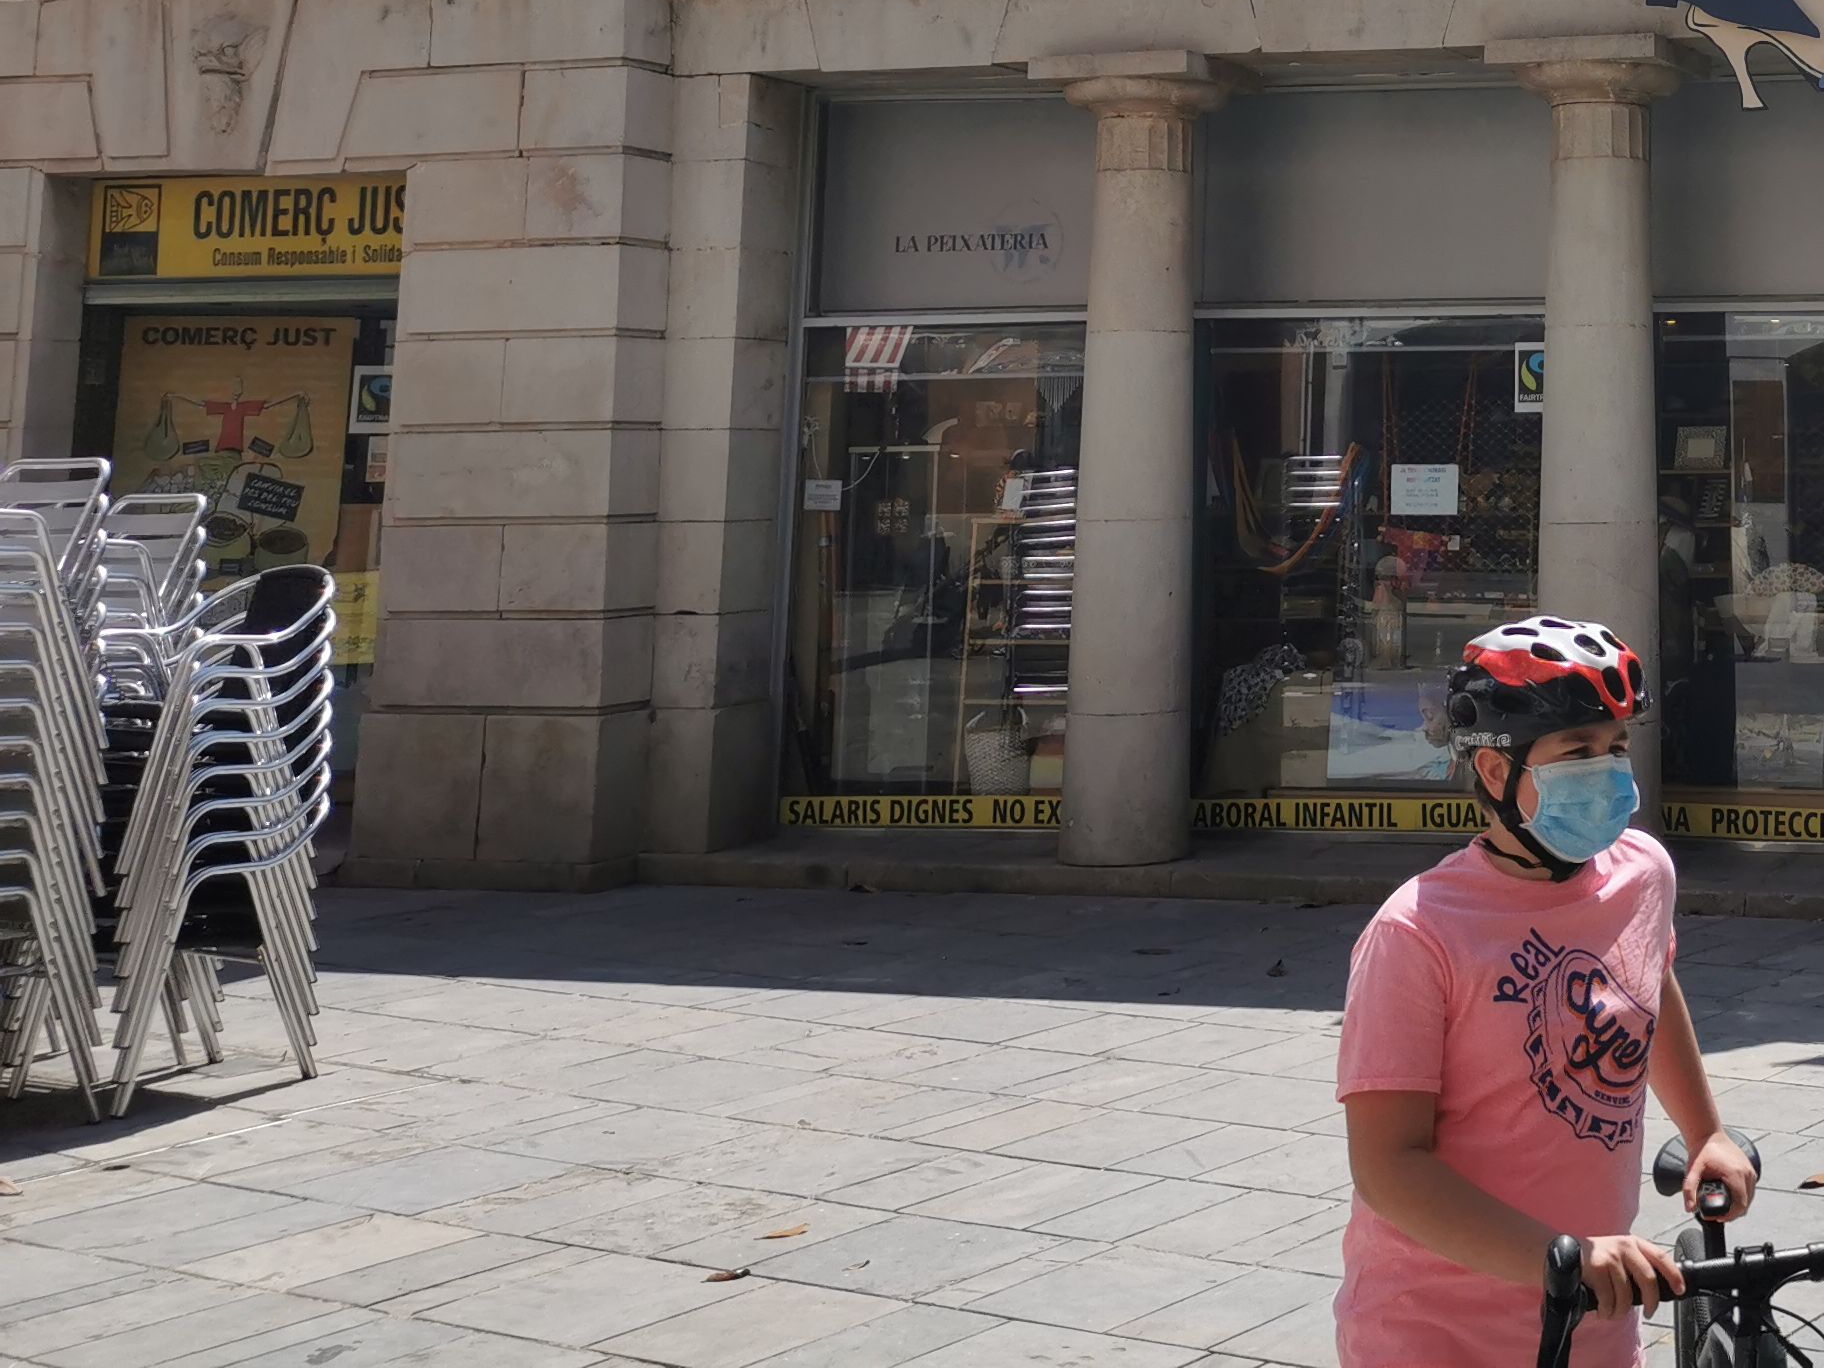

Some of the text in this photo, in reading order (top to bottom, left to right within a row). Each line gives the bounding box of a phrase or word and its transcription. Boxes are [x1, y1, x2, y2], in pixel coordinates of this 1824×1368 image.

[193, 185, 338, 246] COMERÇ
[895, 232, 1049, 253] LA PEIXATERIA
[212, 248, 262, 266] Consum
[267, 247, 347, 269] Responsable
[351, 244, 357, 264] i
[142, 325, 337, 350] COMERÇ JUST
[788, 799, 882, 825] SALARIS
[889, 798, 974, 824] DIGNES
[992, 798, 1026, 824] NO
[1294, 802, 1398, 828] INFANTIL
